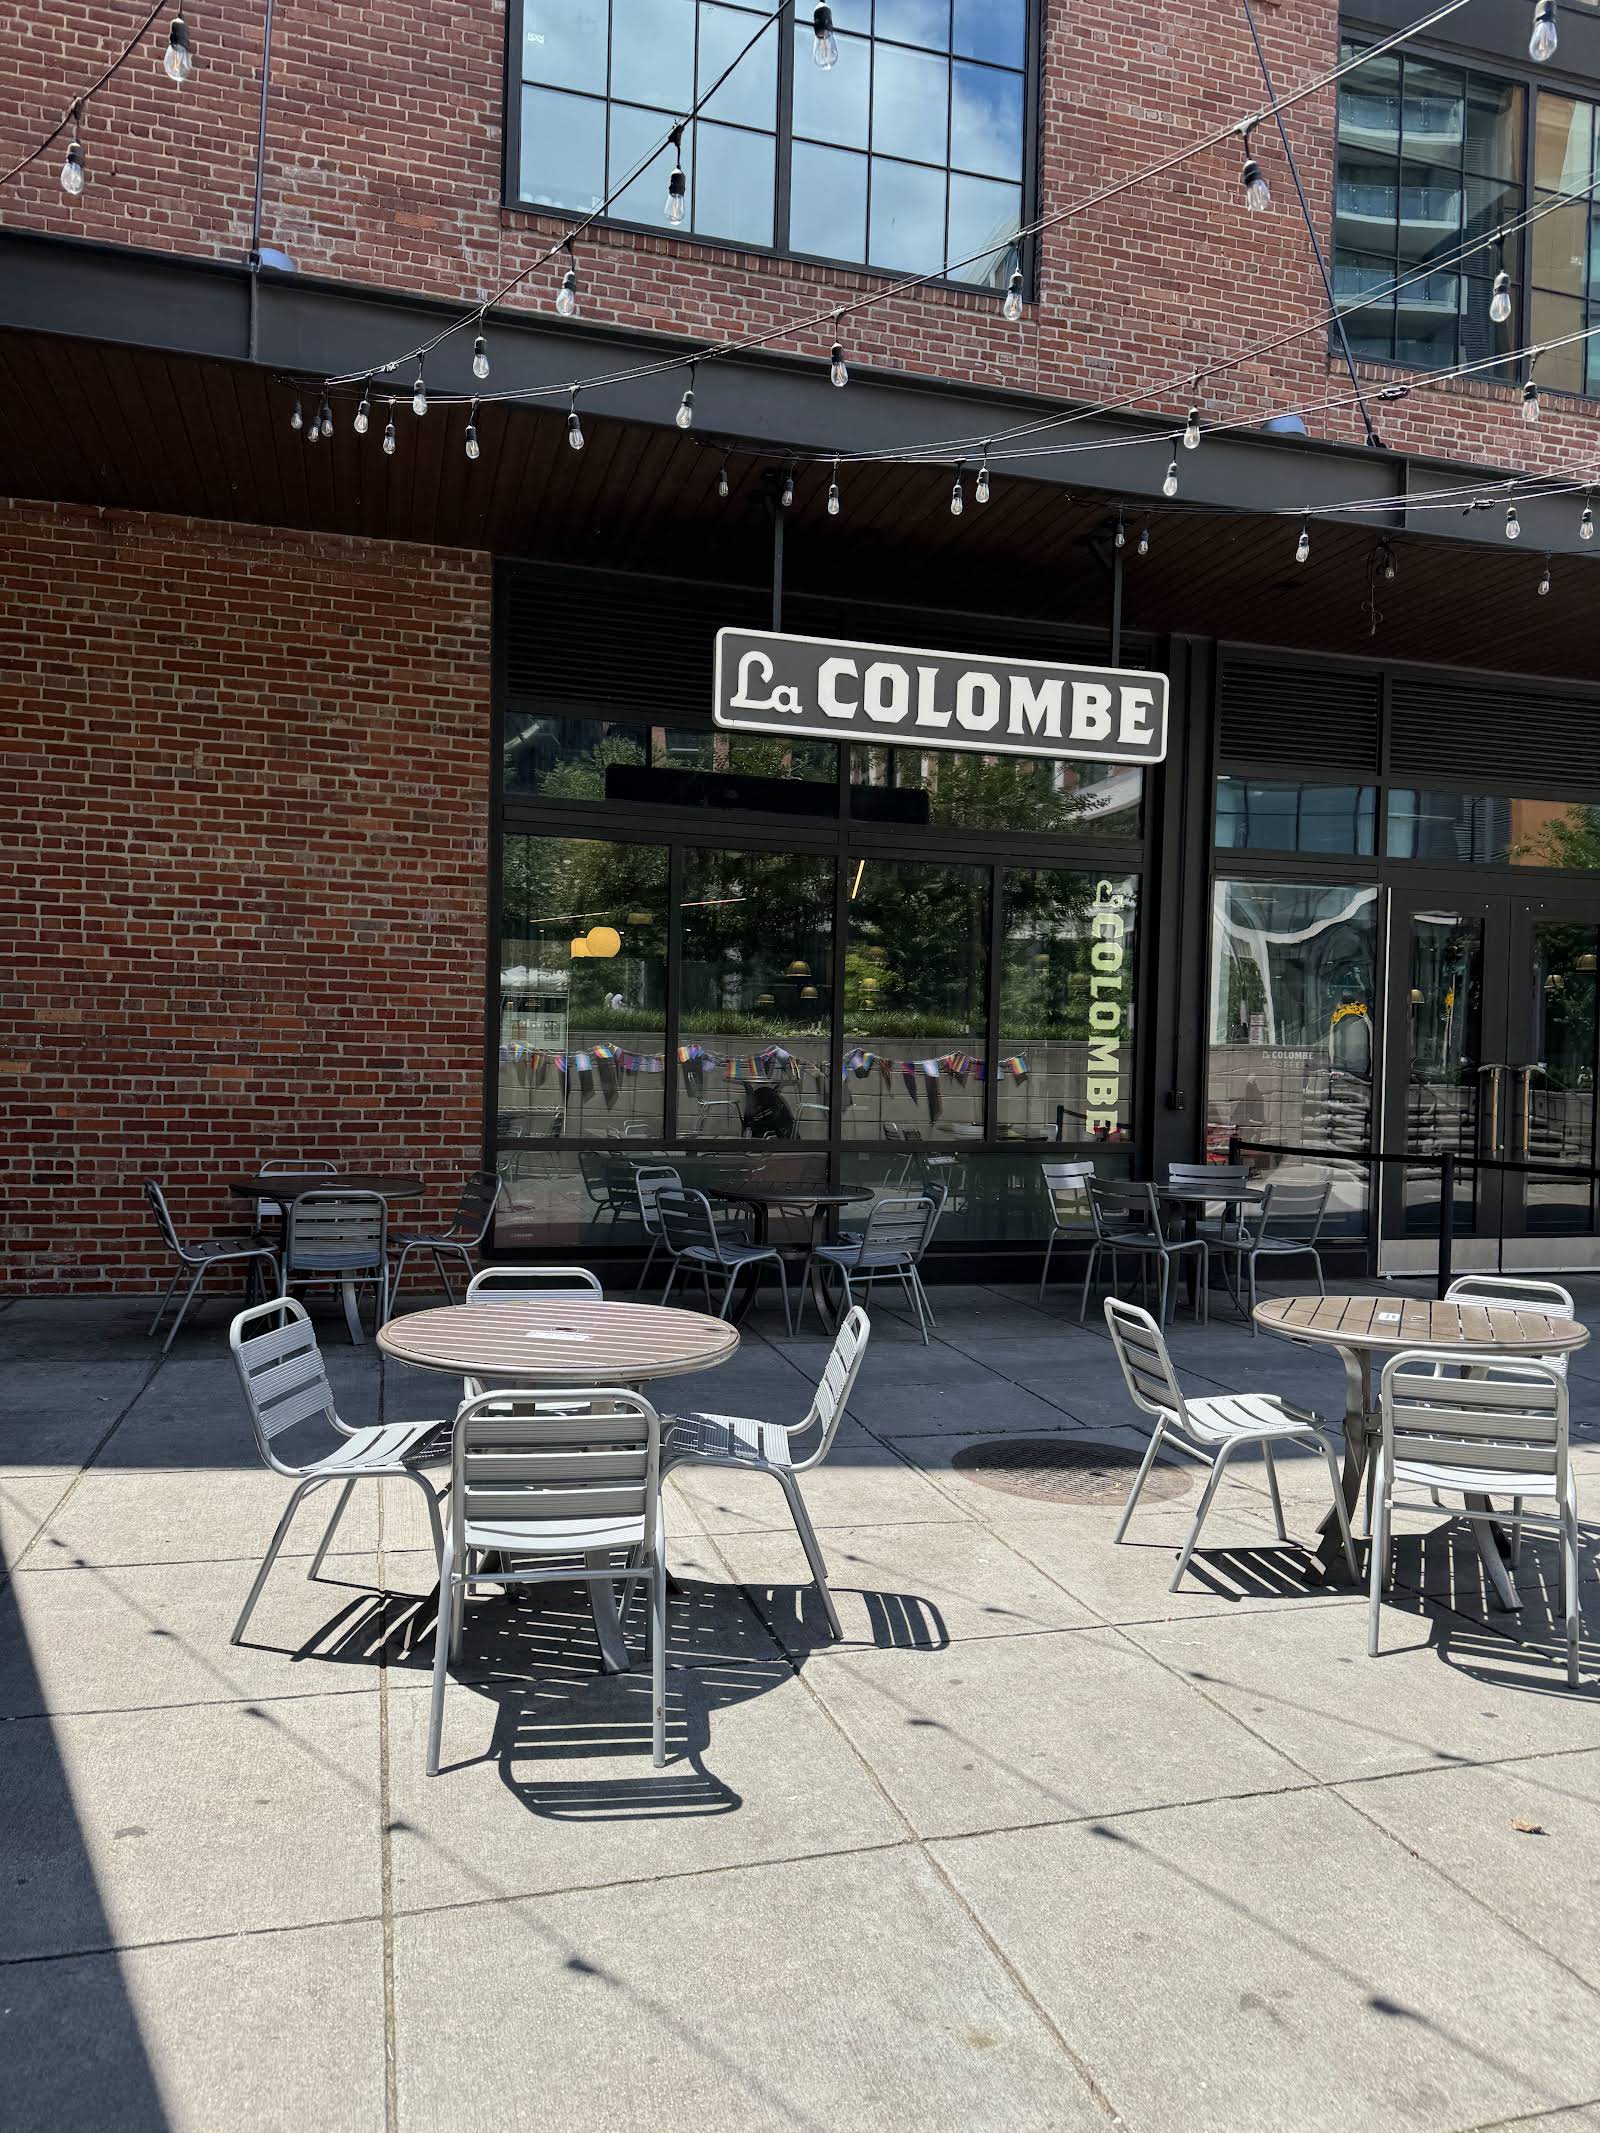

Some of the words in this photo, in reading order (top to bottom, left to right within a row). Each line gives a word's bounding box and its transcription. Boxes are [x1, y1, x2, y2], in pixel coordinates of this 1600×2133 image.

[730, 650, 803, 714] La
[817, 657, 1156, 745] COLOMBE
[1085, 912, 1124, 1136] COLOMBE
[1272, 1051, 1314, 1060] COLOMBE
